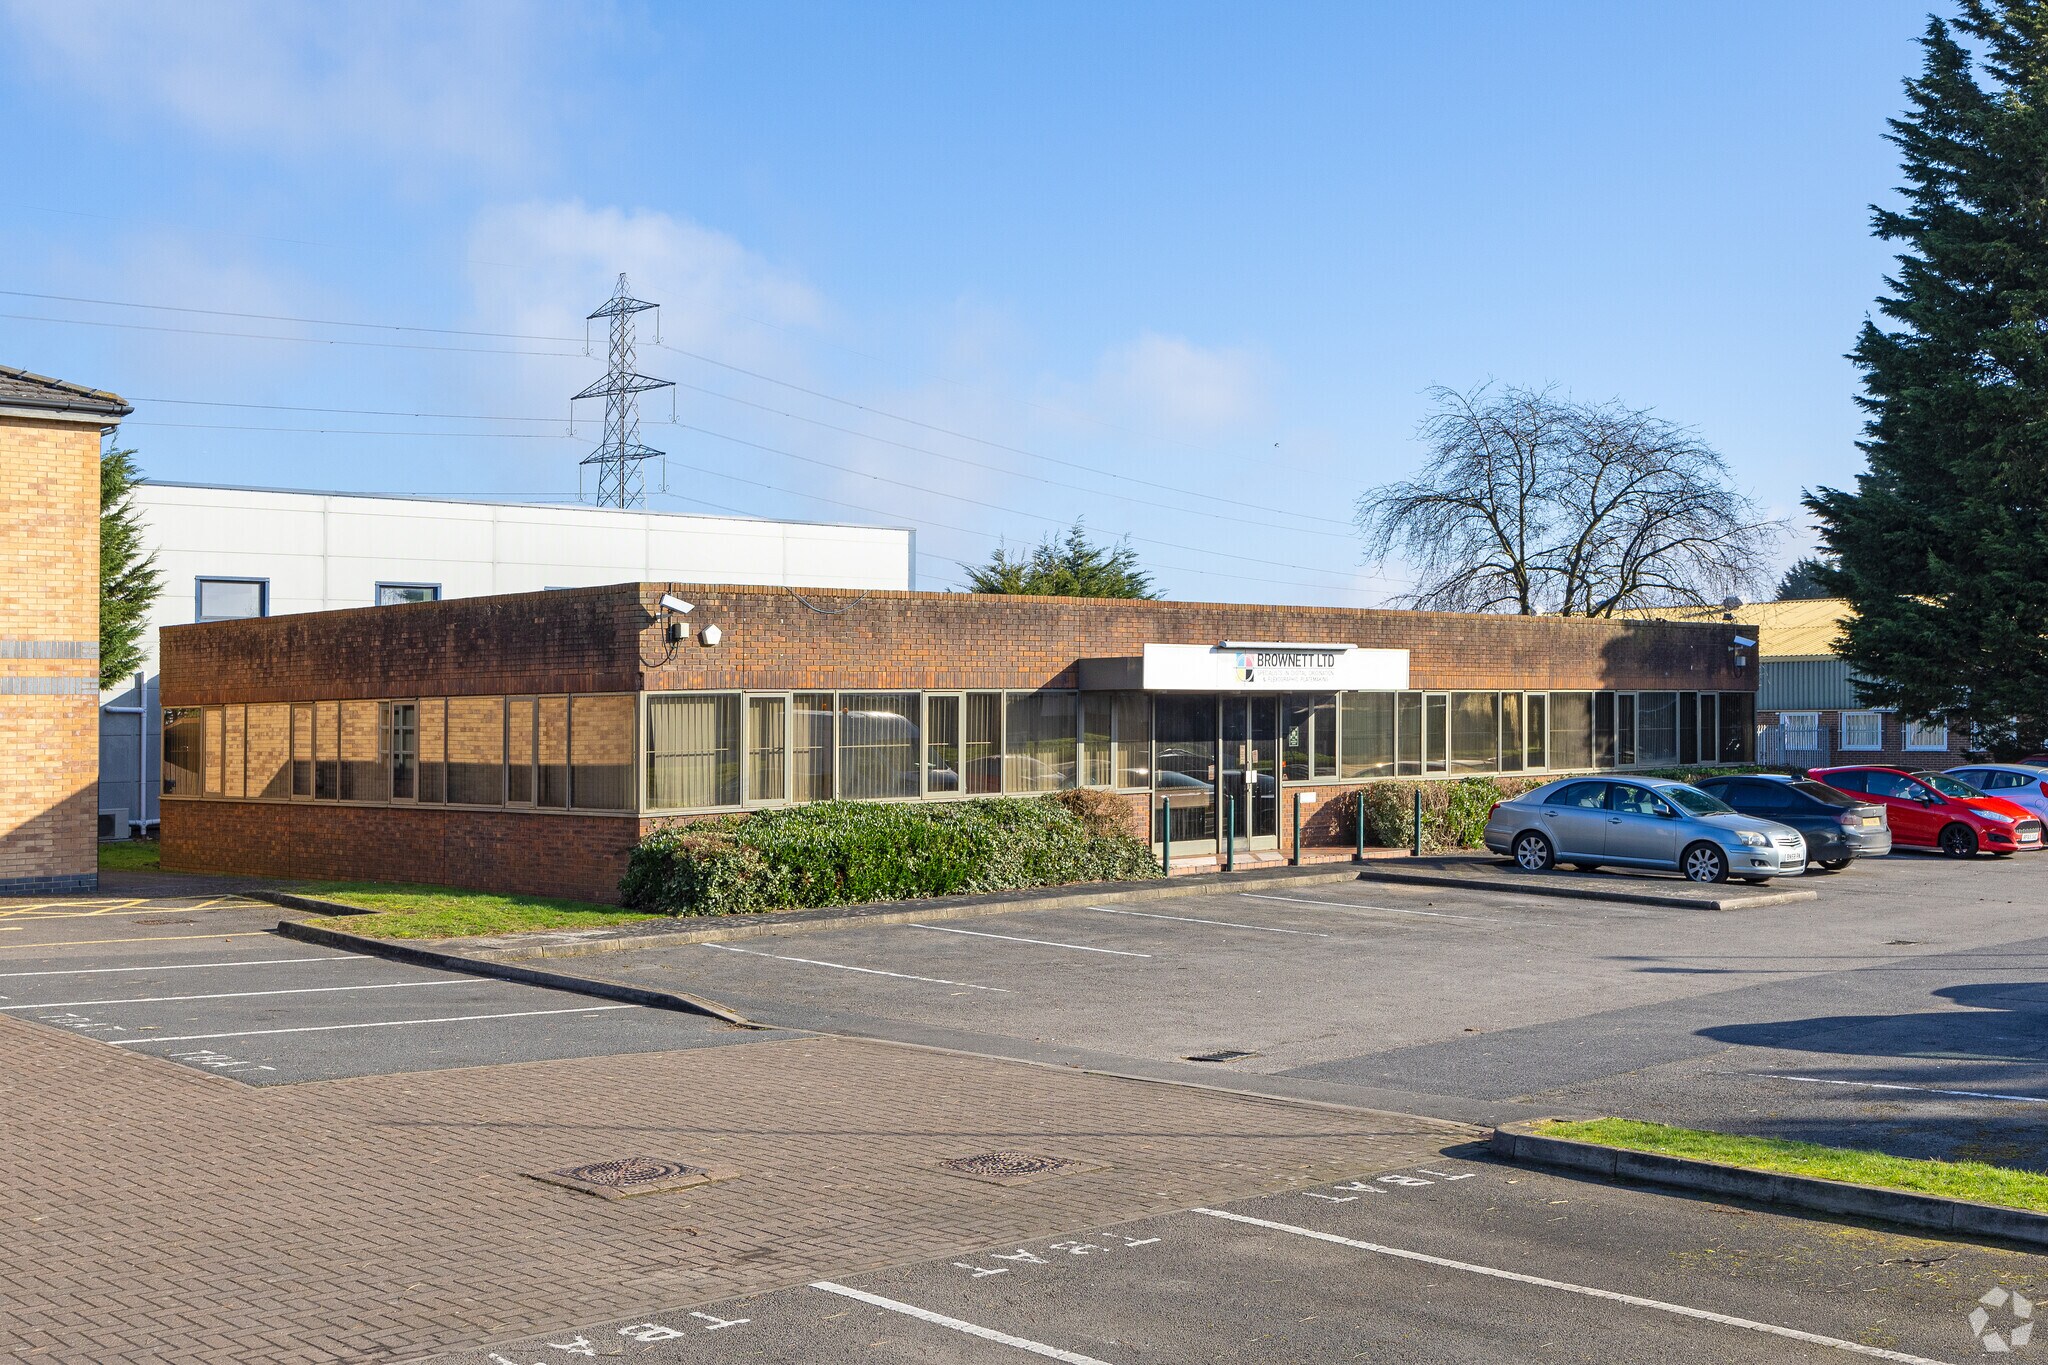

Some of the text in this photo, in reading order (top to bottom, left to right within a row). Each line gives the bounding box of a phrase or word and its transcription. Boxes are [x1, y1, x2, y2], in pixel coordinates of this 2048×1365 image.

[1257, 653, 1335, 667] BROWNETT LTD
[1302, 1169, 1476, 1203] TBAT
